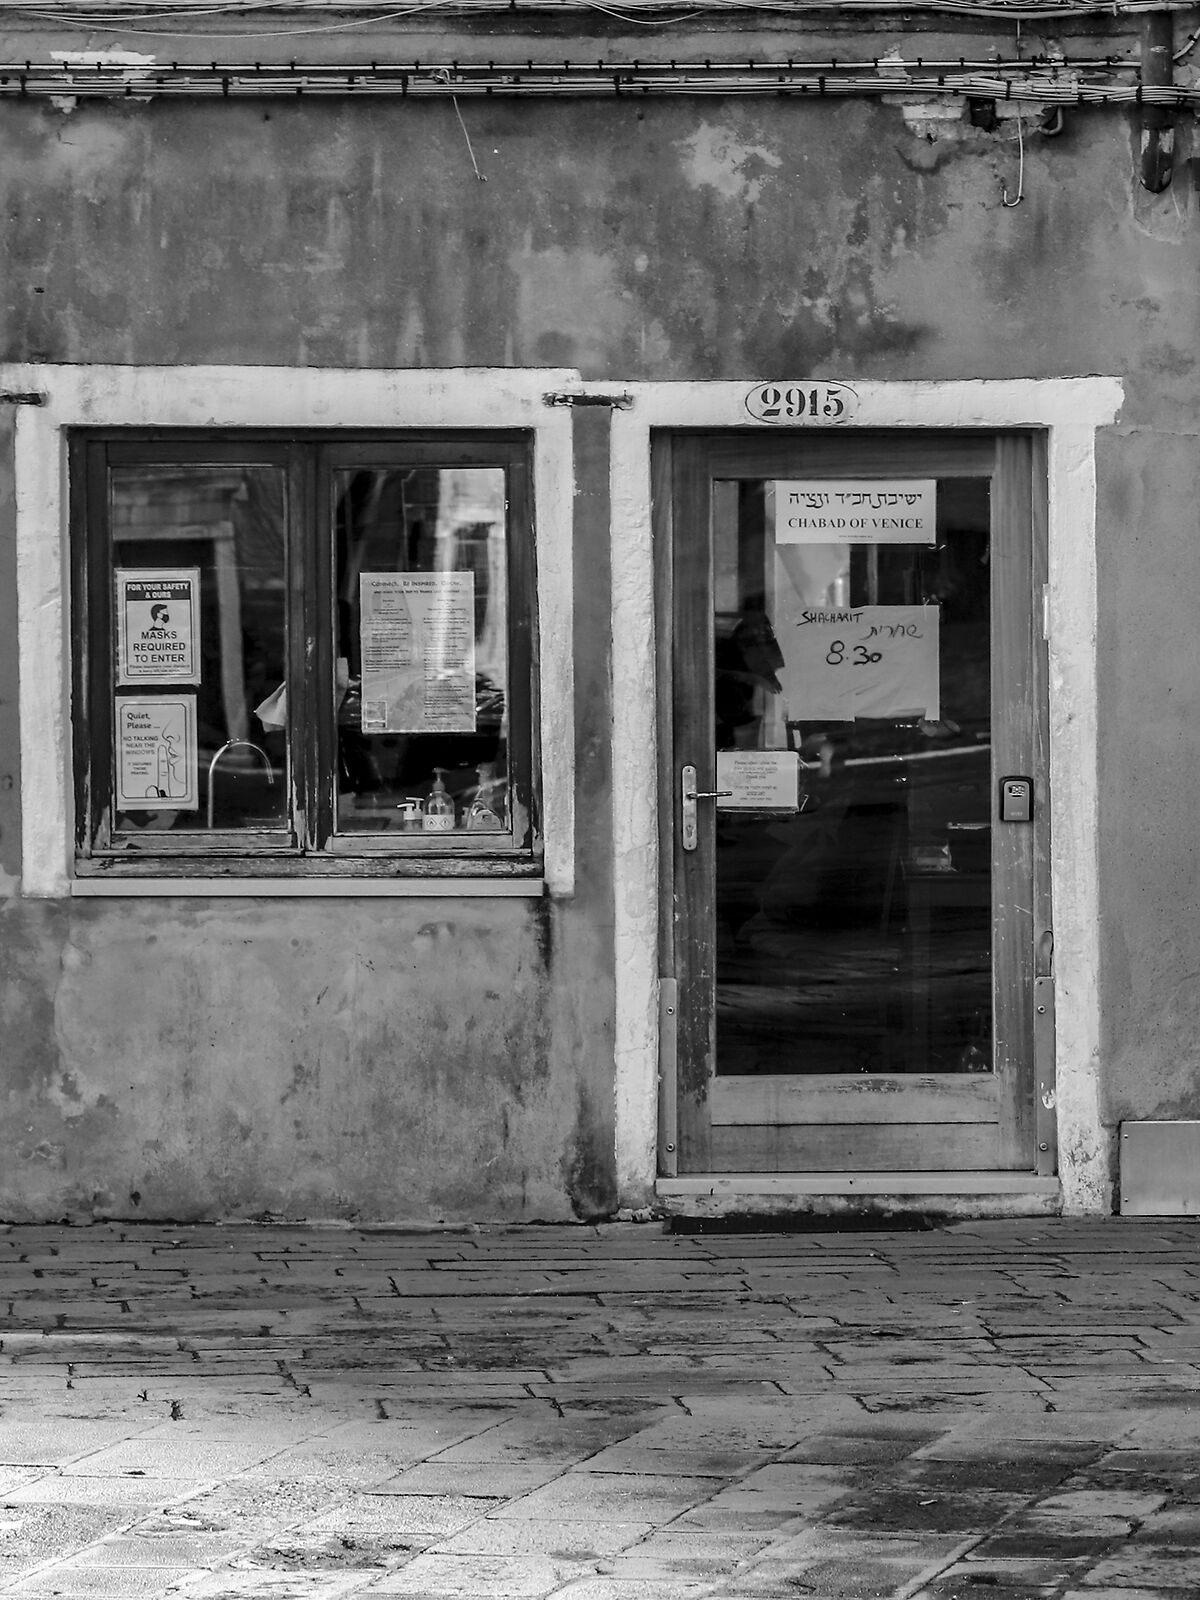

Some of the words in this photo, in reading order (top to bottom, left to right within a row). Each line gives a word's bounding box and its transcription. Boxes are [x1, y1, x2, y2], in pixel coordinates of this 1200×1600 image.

[760, 388, 844, 417] 2915
[789, 493, 830, 509] ונציה
[788, 518, 846, 529] CHABAD
[850, 518, 867, 529] OF
[872, 518, 924, 529] VENICE
[127, 583, 141, 591] FOR
[142, 583, 161, 591] YOUR
[162, 582, 189, 590] SAFETY
[145, 591, 151, 599] &
[152, 591, 171, 599] OURS
[796, 611, 864, 626] SHACHARIT
[141, 630, 177, 640] MASKS
[133, 642, 186, 652] REQUIRED
[135, 654, 148, 663] TO
[151, 654, 185, 662] ENTER
